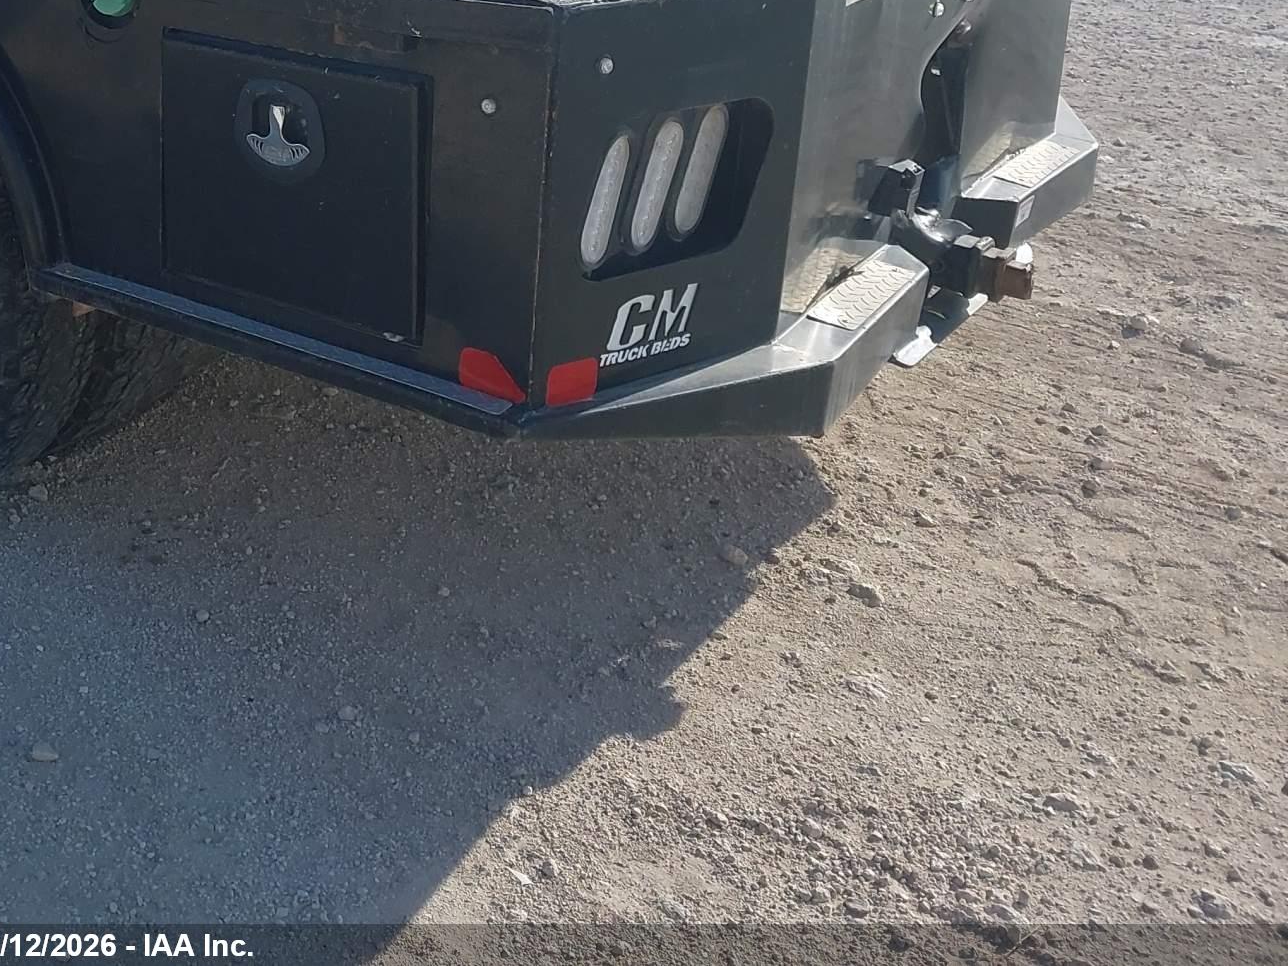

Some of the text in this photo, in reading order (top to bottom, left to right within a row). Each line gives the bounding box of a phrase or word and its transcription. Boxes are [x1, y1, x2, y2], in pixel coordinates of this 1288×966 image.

[606, 282, 699, 351] CM
[599, 333, 692, 368] TRUCK BEDS
